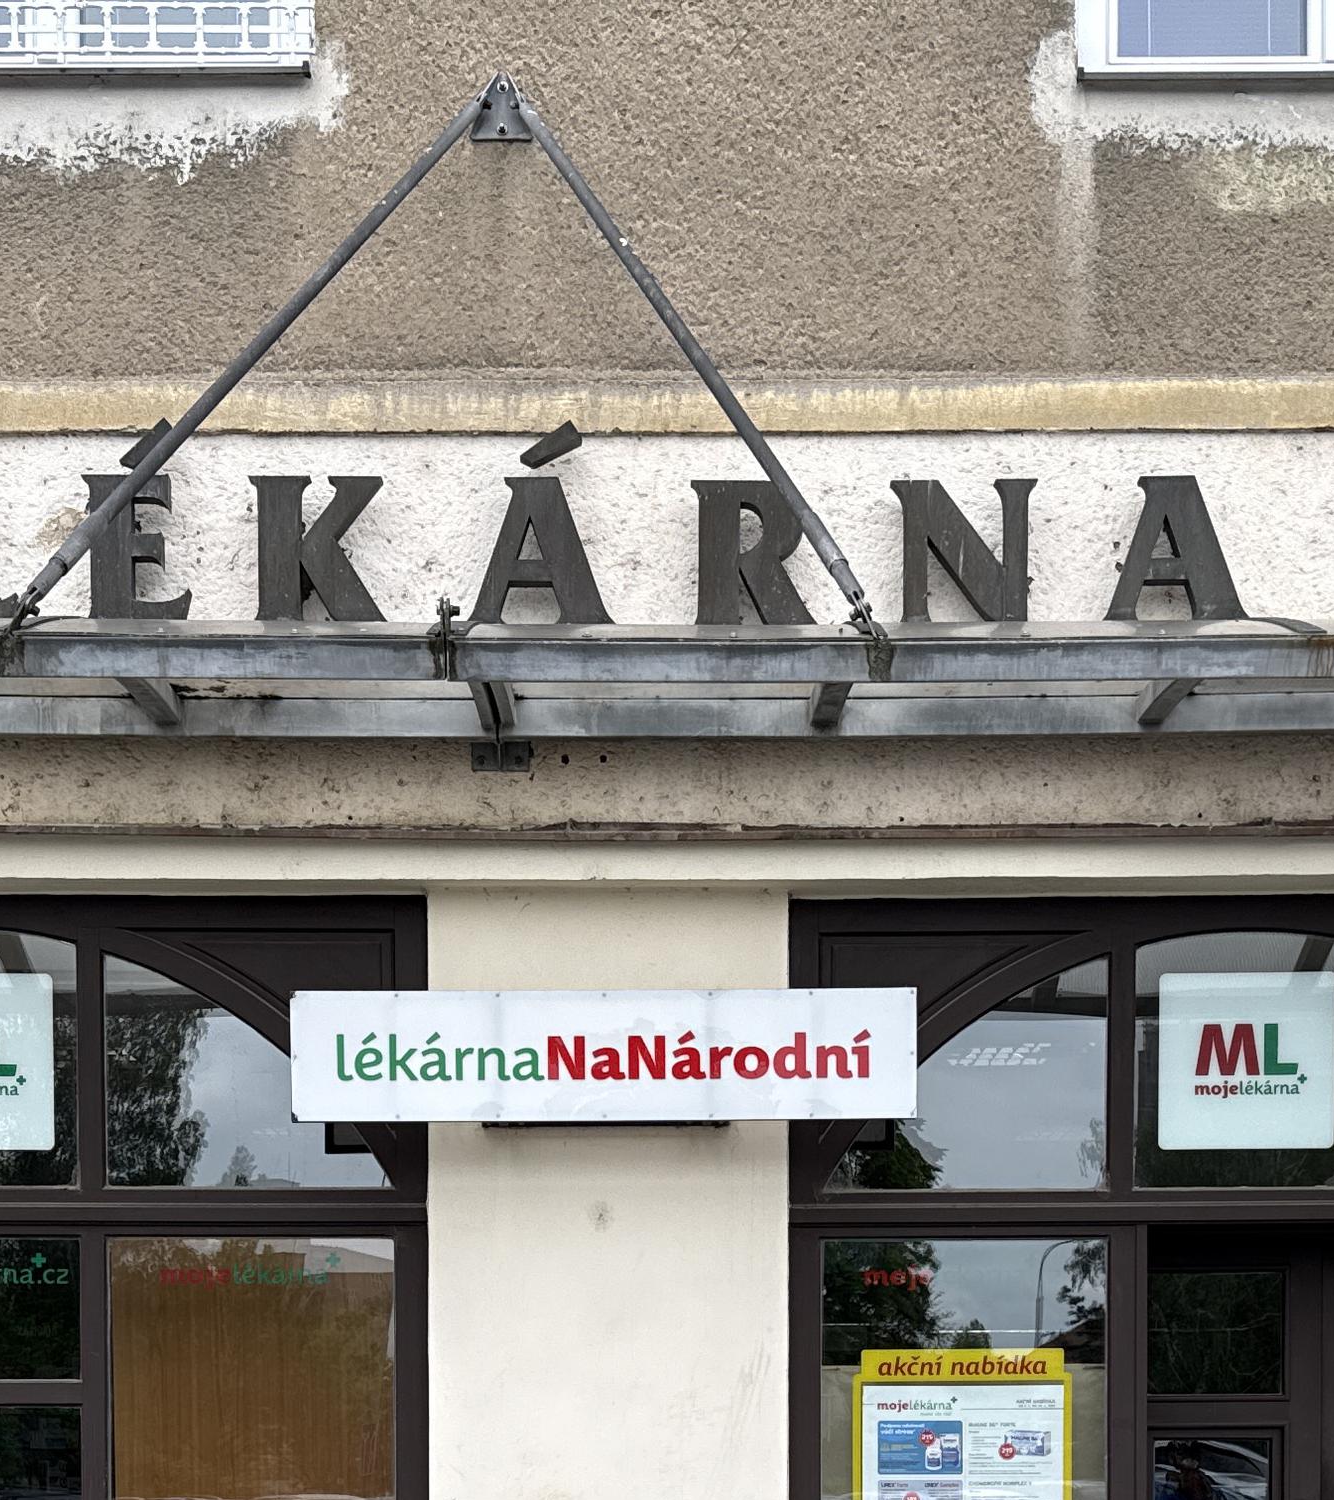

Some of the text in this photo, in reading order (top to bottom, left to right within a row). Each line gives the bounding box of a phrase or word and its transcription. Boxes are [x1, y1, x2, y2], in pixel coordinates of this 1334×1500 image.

[335, 1028, 872, 1082] lékárnaNaNárodní
[1194, 1023, 1299, 1076] ML
[1194, 1080, 1300, 1099] mojelékárna
[877, 1355, 1048, 1376] akční nabídka
[876, 1398, 953, 1413] mojelékárna
